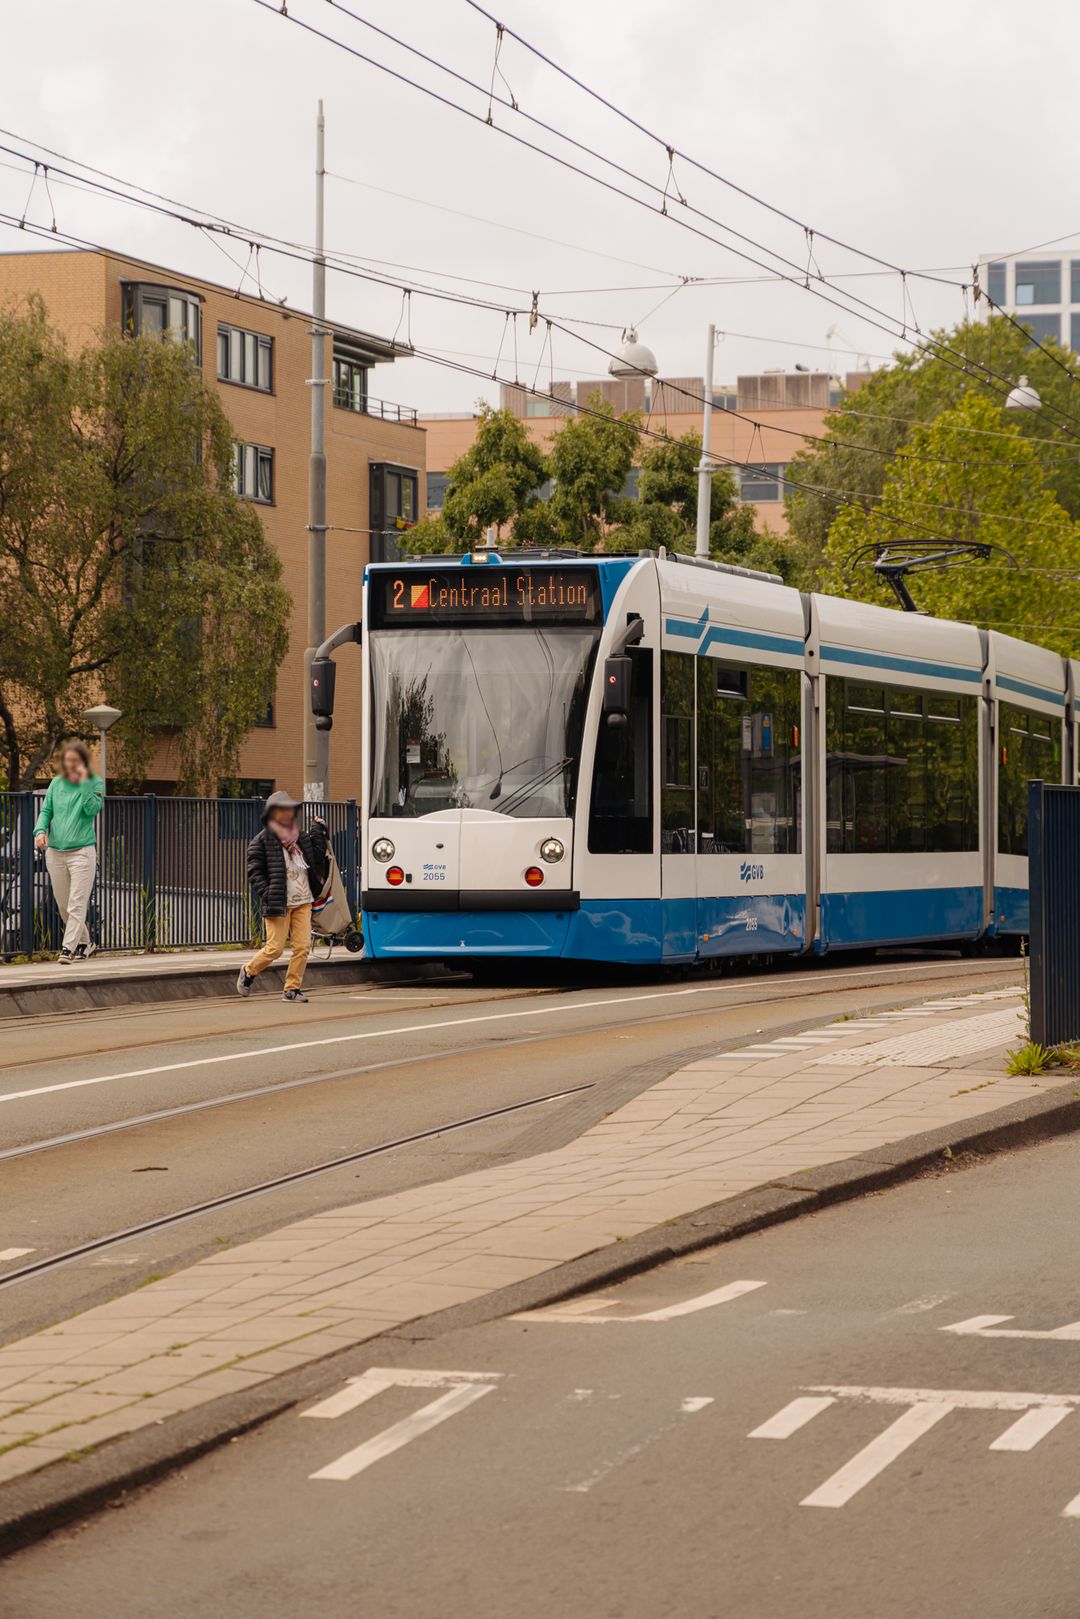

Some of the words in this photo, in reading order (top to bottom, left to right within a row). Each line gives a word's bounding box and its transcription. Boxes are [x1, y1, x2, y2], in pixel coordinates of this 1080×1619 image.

[393, 580, 404, 608] 2
[428, 577, 507, 607] Centraal
[516, 576, 587, 606] Station
[423, 872, 445, 881] 2055
[752, 865, 764, 879] GVB
